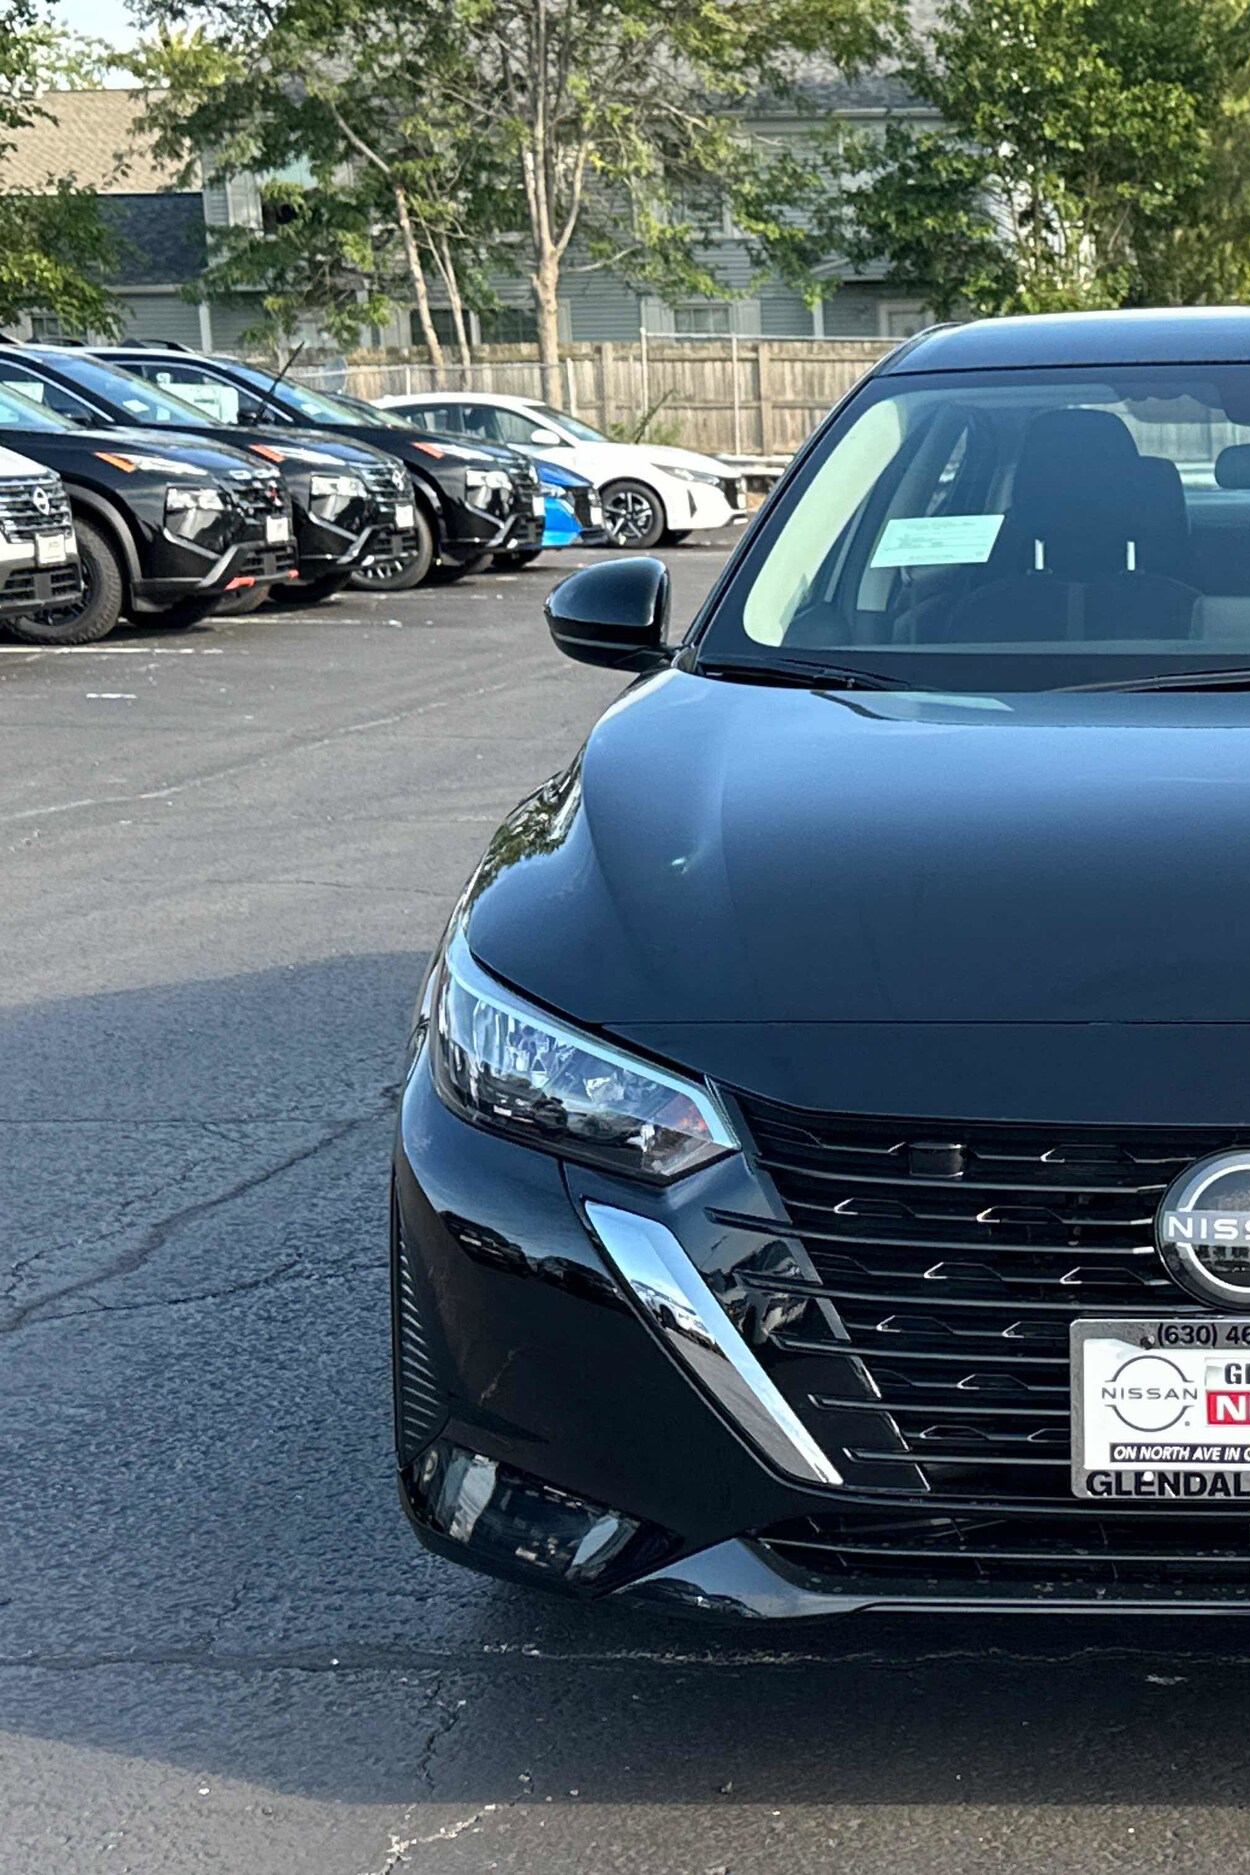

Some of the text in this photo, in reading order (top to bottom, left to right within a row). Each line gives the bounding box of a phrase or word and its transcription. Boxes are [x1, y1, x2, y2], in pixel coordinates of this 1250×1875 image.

[1157, 1323, 1218, 1347] (630)
[1101, 1387, 1198, 1400] NISSAN
[1113, 1445, 1137, 1460] ON
[1139, 1446, 1190, 1461] NORTH
[1192, 1447, 1221, 1461] AVE
[1224, 1447, 1241, 1461] IN
